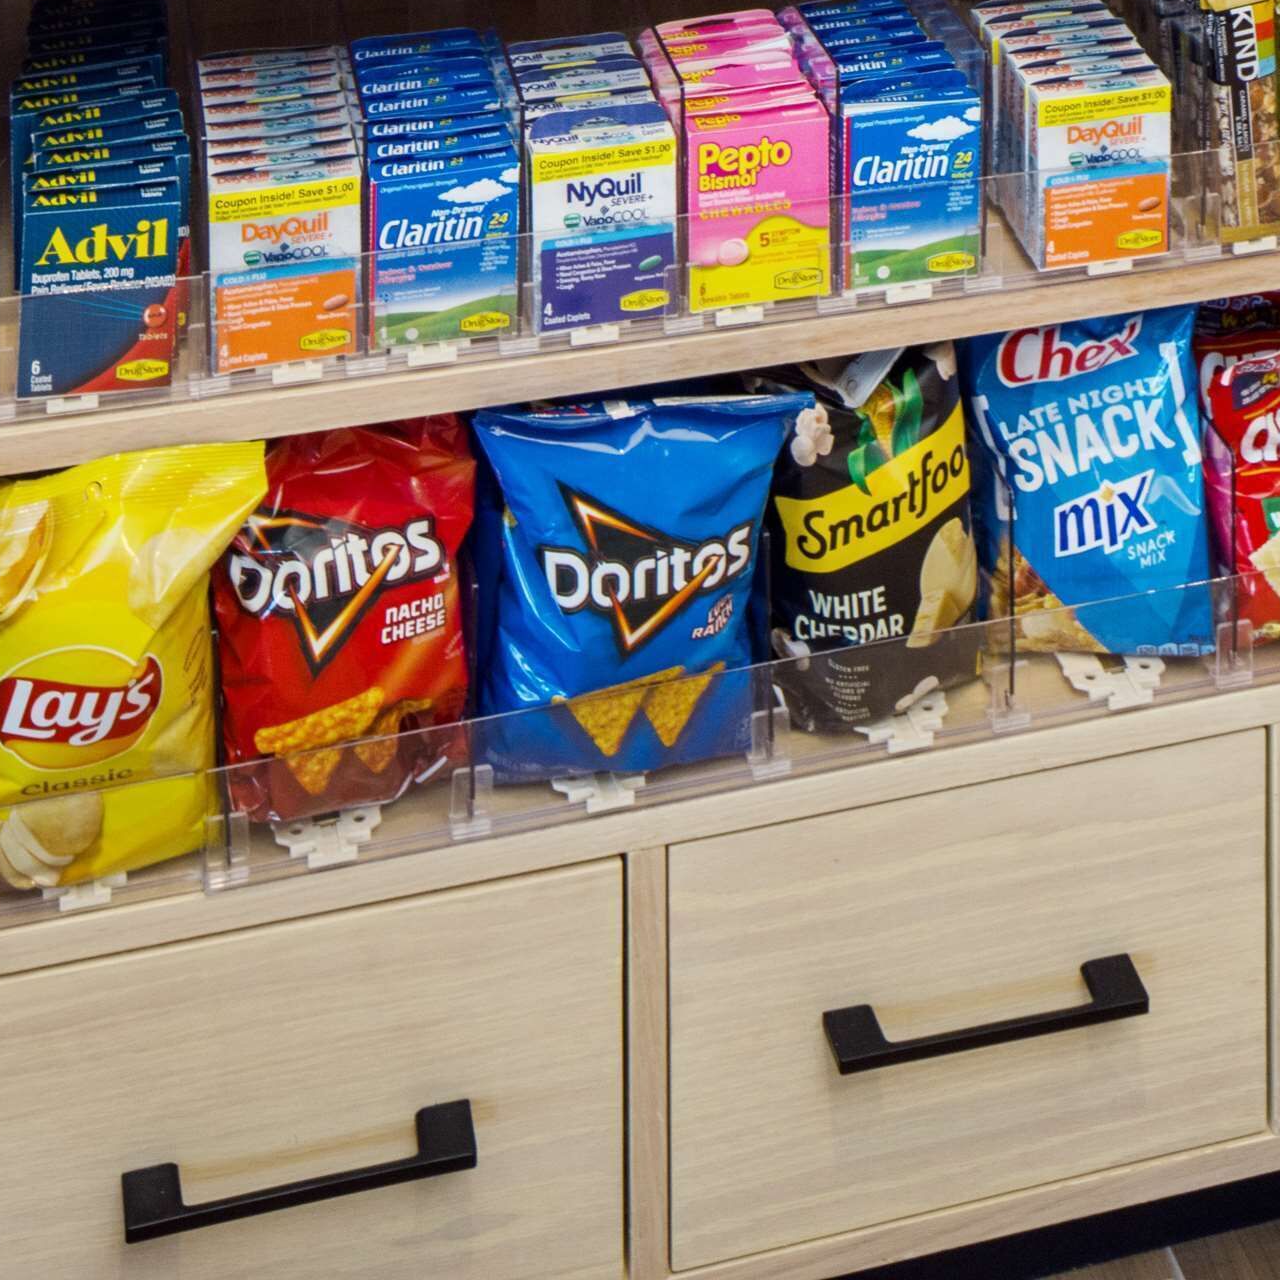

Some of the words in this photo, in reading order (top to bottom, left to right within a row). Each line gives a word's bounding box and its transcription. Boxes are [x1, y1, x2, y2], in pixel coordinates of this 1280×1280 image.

[1230, 6, 1257, 82] KIND
[362, 78, 422, 95] Claritin
[18, 93, 78, 110] Advil
[368, 96, 429, 114] Claritin
[1045, 101, 1082, 113] Coupon
[1084, 97, 1114, 108] Inside!
[1117, 95, 1139, 103] Save
[1141, 90, 1165, 100] $1.00
[40, 108, 101, 127] Advil
[372, 119, 434, 137] Claritin
[1066, 116, 1143, 145] DayQuil
[42, 128, 103, 147] Advil
[376, 138, 440, 158] Claritin
[47, 148, 110, 164] Advil
[381, 158, 445, 177] Claritin
[539, 156, 579, 170] Coupon
[582, 151, 615, 163] Inside!
[619, 148, 642, 158] Save
[645, 144, 671, 154] $1.00
[698, 137, 792, 174] Pepto
[31, 170, 96, 190] Advil
[698, 171, 757, 192] Bismol
[852, 152, 950, 187] Claritin
[955, 152, 973, 163] 24
[31, 191, 97, 207] Advil
[215, 197, 257, 209] Coupon
[259, 190, 295, 203] Inside!
[298, 188, 324, 198] Save
[327, 182, 354, 195] $1.00
[566, 172, 642, 207] NyQuil
[611, 195, 647, 207] SEVERE
[241, 211, 329, 244] DayQuil
[583, 207, 649, 227] VapoCOOL
[34, 218, 168, 266] Advil
[379, 216, 483, 250] Claritin
[489, 212, 509, 224] 24
[759, 232, 770, 247] 5
[31, 272, 70, 284] Ibuprofen
[71, 270, 102, 281] Tablets,
[104, 268, 120, 278] 200
[120, 267, 134, 279] mg
[544, 303, 552, 316] 4
[997, 314, 1143, 388] Chex
[31, 360, 41, 374] 6
[998, 400, 1060, 441] LATE
[1007, 397, 1176, 493] SNACK
[796, 447, 969, 561] Smartfoo
[1054, 471, 1156, 558] mix
[1128, 529, 1176, 561] SNACK
[229, 518, 445, 619] Doritos
[543, 523, 753, 612] Doritos
[1139, 550, 1167, 570] MIX
[384, 592, 445, 625] NACHO
[809, 585, 888, 619] WHITE
[380, 610, 446, 647] CHEESE
[1, 671, 156, 747] Lay's
[19, 766, 135, 797] Classic
